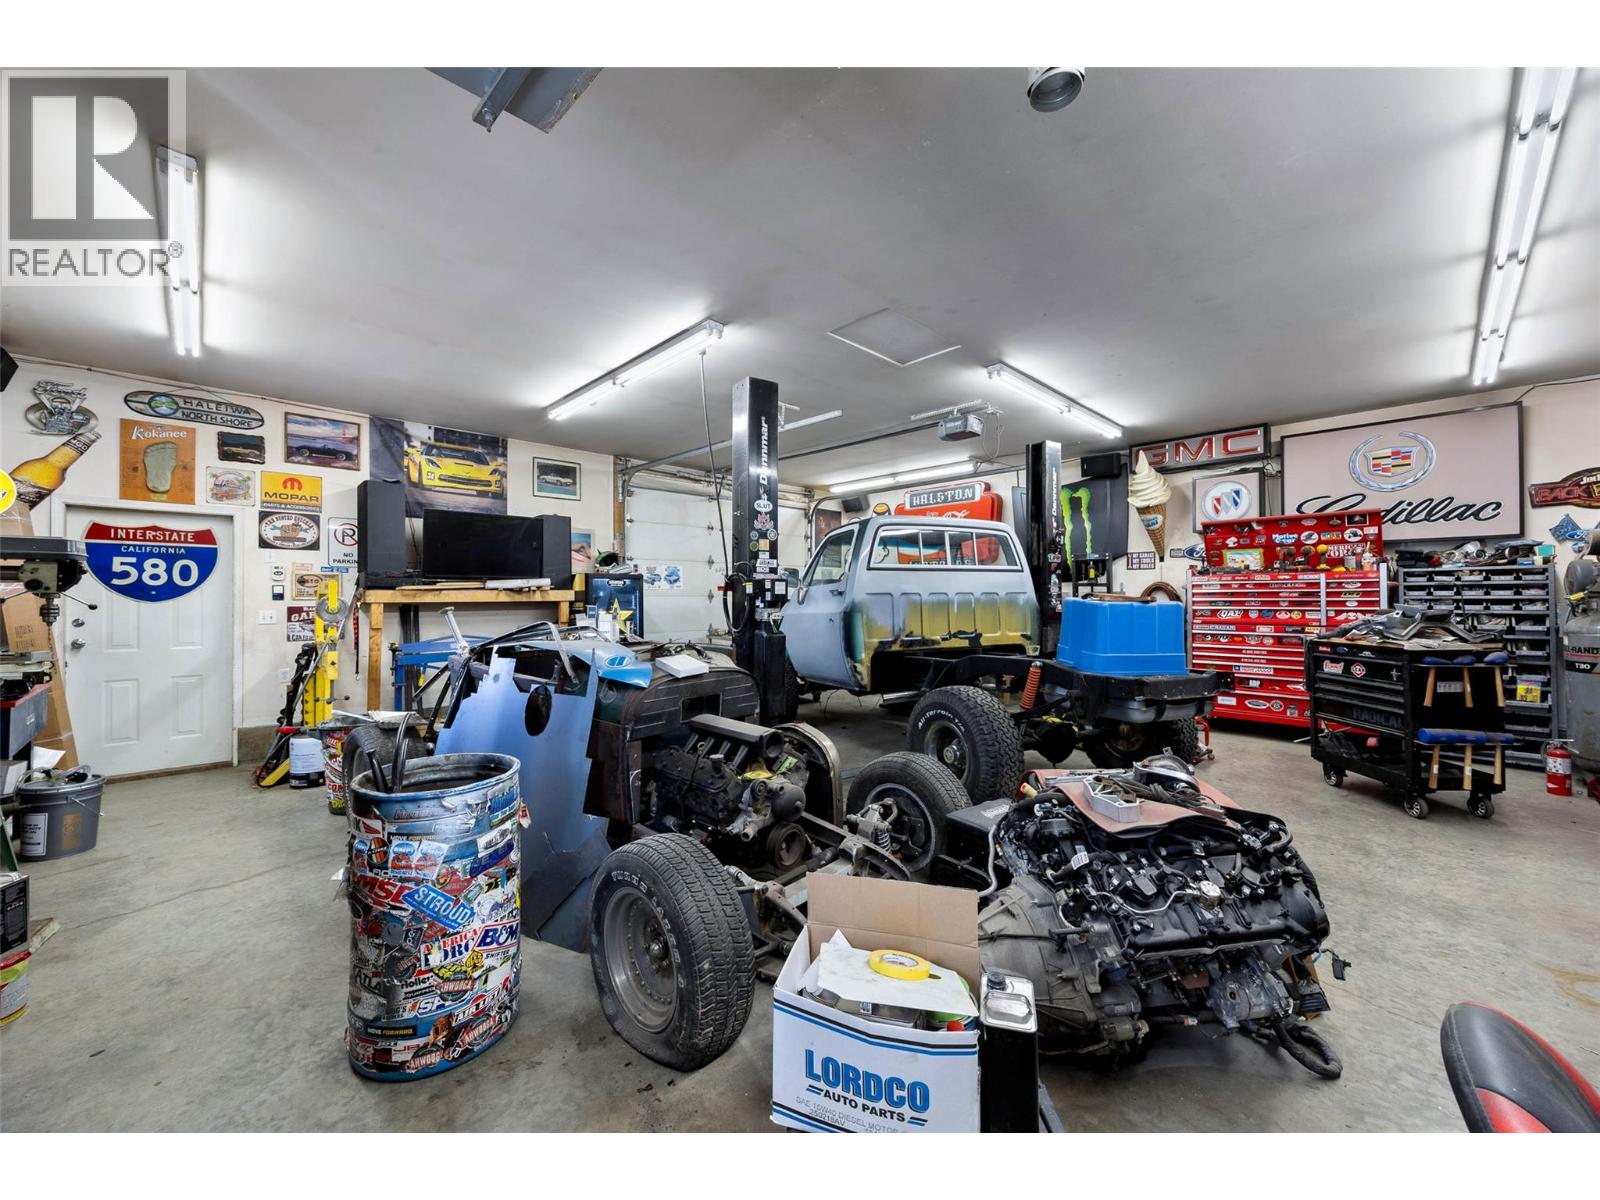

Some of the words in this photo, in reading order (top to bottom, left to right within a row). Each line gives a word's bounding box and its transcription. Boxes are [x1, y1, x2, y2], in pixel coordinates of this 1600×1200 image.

[183, 399, 251, 415] HALEIWA
[181, 410, 218, 422] NORTH
[220, 416, 253, 428] SHORE
[131, 426, 187, 440] Kokanee
[1136, 429, 1261, 466] GMC
[264, 491, 319, 503] MOPAR
[912, 487, 973, 506] HALSTON
[1295, 492, 1503, 525] Cdillac
[110, 528, 195, 542] INTERSTATE
[121, 545, 186, 554] CALIFORNIA
[110, 556, 199, 587] 580
[477, 922, 520, 949] B&M
[804, 1048, 930, 1114] LORDCO
[823, 1090, 858, 1109] AUTO
[861, 1103, 906, 1123] PARTS
[838, 1110, 866, 1128] DIESEL
